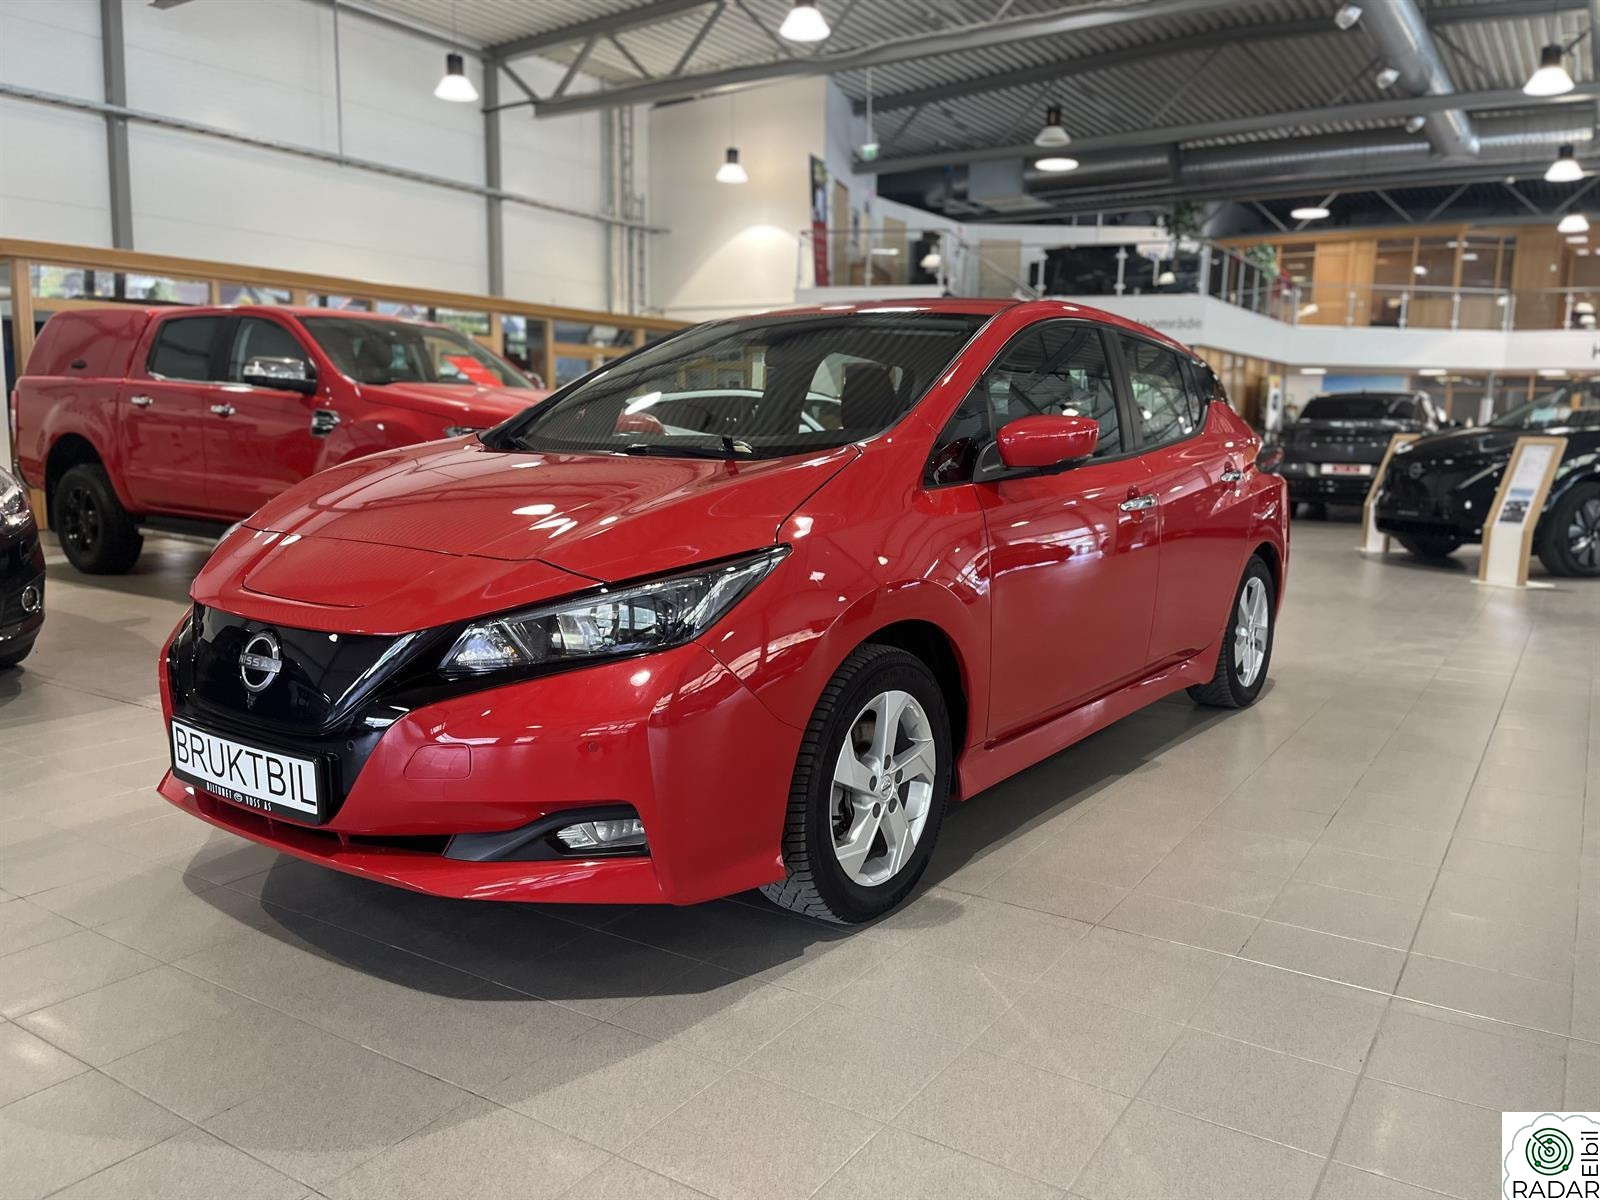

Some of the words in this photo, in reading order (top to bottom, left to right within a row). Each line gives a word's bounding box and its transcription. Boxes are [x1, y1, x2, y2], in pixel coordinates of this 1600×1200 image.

[239, 654, 281, 671] NISSAN
[176, 726, 317, 806] BRUKTBIL
[245, 795, 260, 809] VOSS
[263, 801, 272, 811] AS
